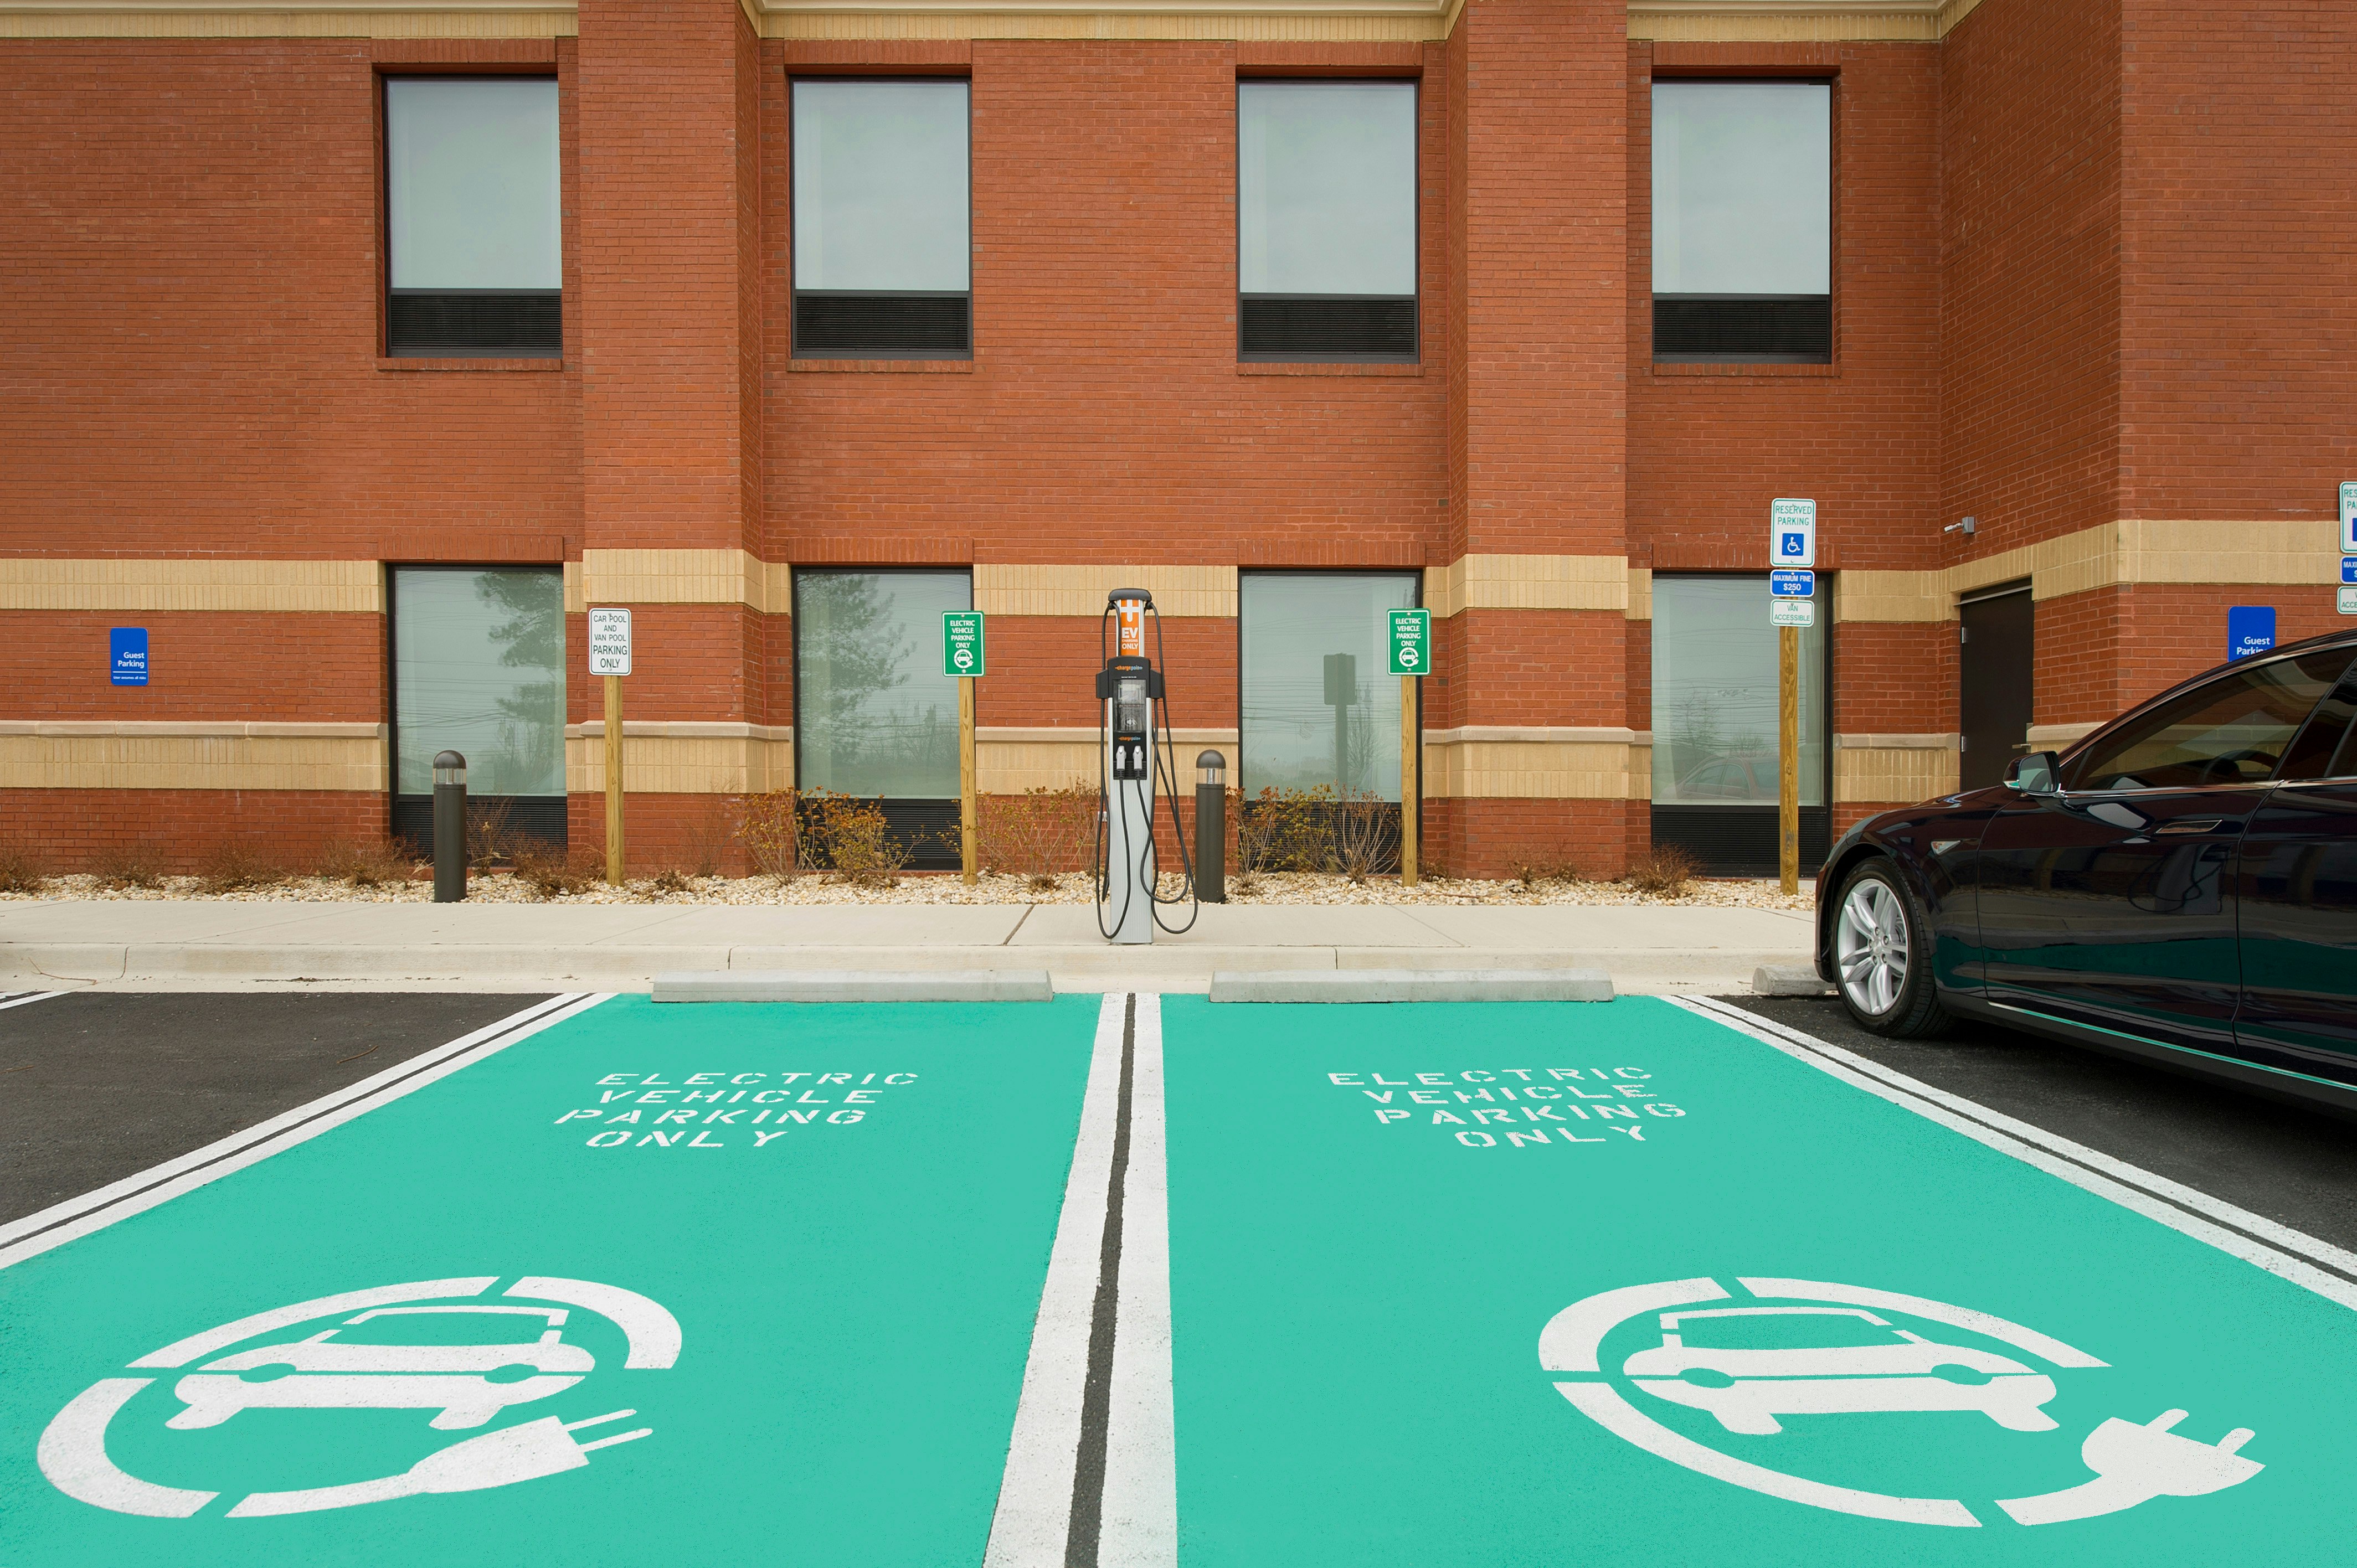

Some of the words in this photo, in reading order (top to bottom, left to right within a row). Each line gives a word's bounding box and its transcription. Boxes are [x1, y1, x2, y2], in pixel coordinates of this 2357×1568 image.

[1776, 506, 1812, 514] RESERVED
[1778, 517, 1809, 525] PARKING
[1121, 627, 1138, 638] EV
[2244, 636, 2270, 645] Guest
[593, 645, 627, 655] PARKING
[117, 659, 145, 669] Parking
[600, 658, 620, 668] ONLY
[595, 1073, 918, 1085] ELECTRIC
[1327, 1067, 1652, 1085] ELECTRIC
[599, 1090, 883, 1103] VEHICLE
[1362, 1084, 1658, 1104] VEHICLE
[554, 1110, 866, 1125] PARKING
[1373, 1103, 1686, 1125] PARKING
[586, 1131, 789, 1147] ONLY
[1454, 1126, 1646, 1148] ONLY
